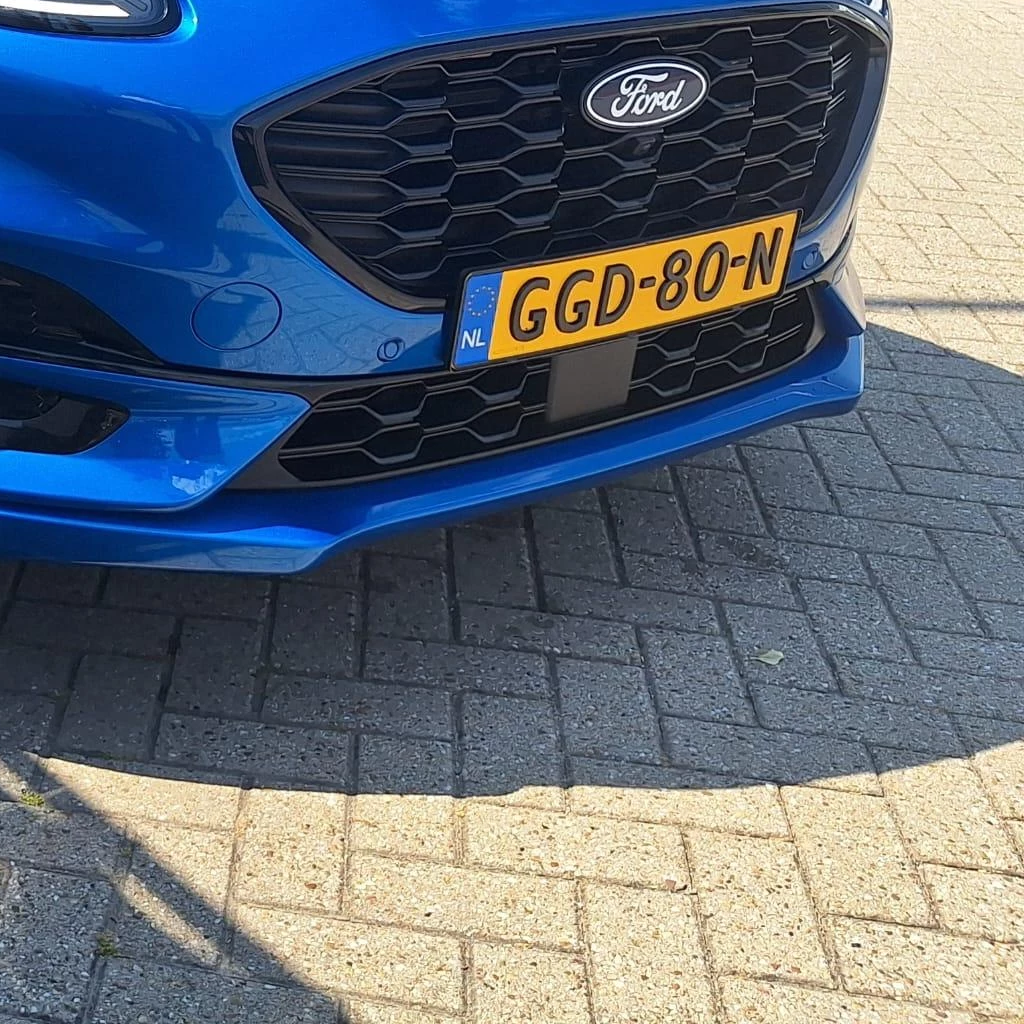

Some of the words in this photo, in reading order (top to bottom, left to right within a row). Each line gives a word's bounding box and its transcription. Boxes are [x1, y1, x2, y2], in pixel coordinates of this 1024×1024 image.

[610, 72, 687, 118] Ford
[508, 226, 785, 342] GGD-80-N
[460, 327, 486, 349] NL
